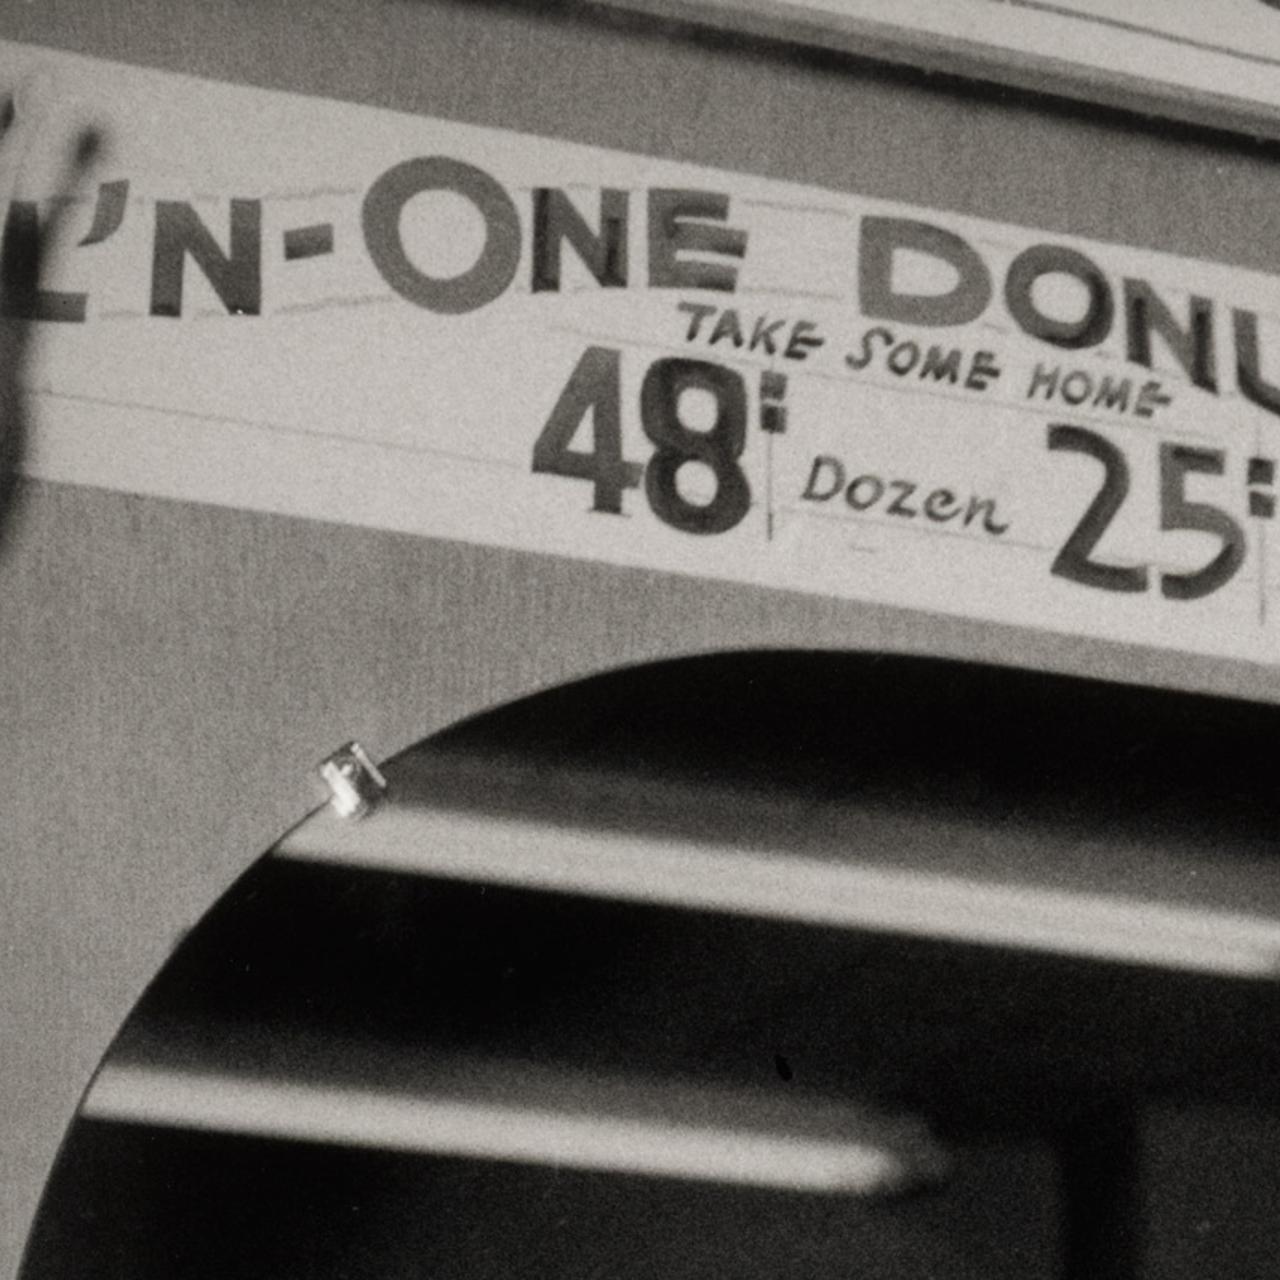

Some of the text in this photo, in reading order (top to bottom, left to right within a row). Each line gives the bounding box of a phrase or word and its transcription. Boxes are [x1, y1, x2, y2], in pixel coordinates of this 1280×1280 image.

[676, 302, 1172, 418] TAKE SOME HOME
[801, 454, 1010, 537] Dozen
